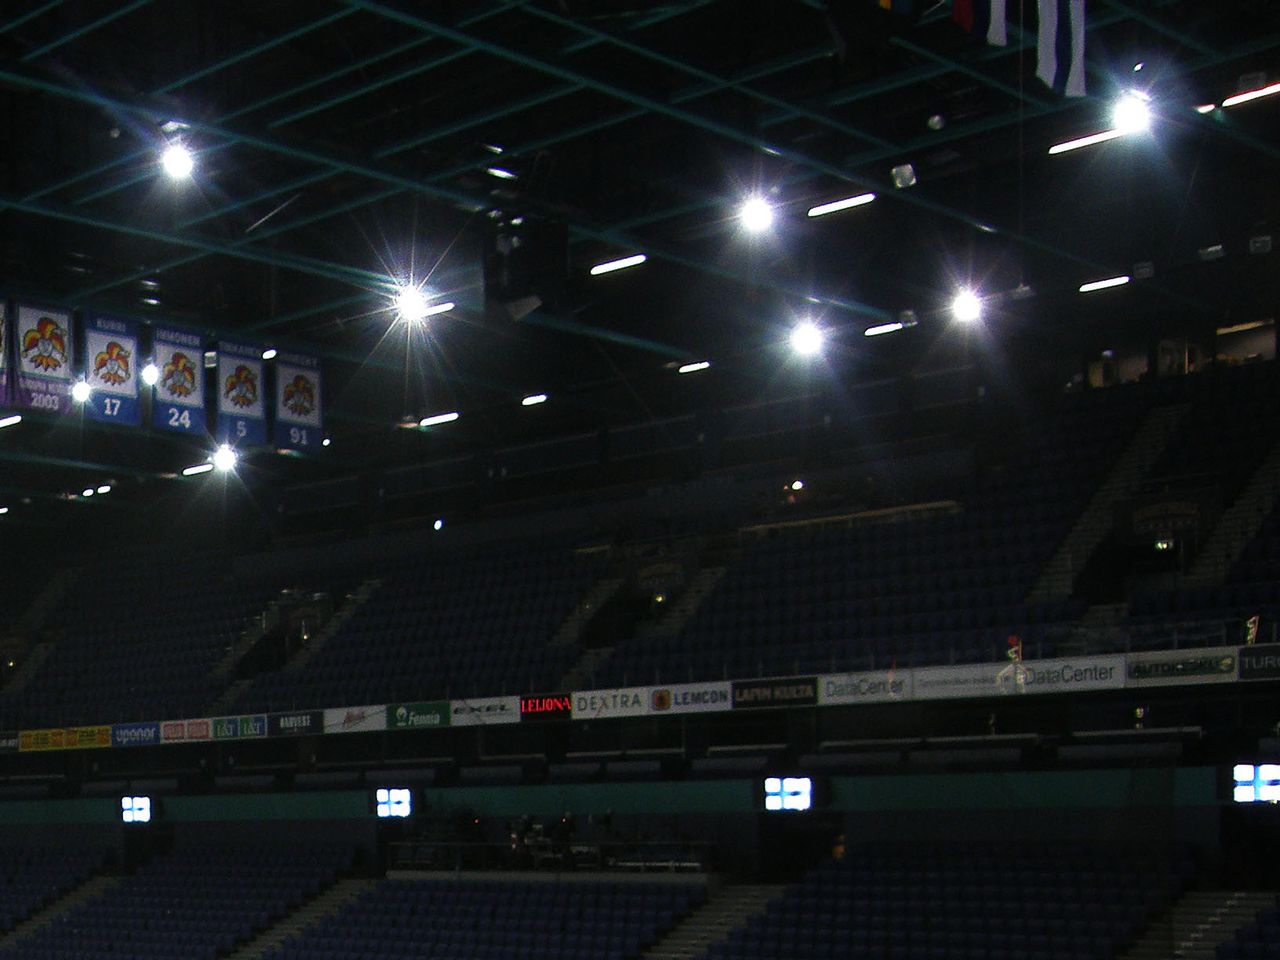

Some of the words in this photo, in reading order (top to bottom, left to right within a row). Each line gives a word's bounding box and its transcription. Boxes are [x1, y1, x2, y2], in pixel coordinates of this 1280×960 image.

[104, 398, 120, 416] 17
[169, 408, 191, 428] 24
[237, 421, 246, 437] 5
[290, 427, 308, 445] 91
[1023, 664, 1115, 685] DataCenter
[520, 696, 572, 713] LEIJONA
[578, 694, 642, 711] DEXTRA
